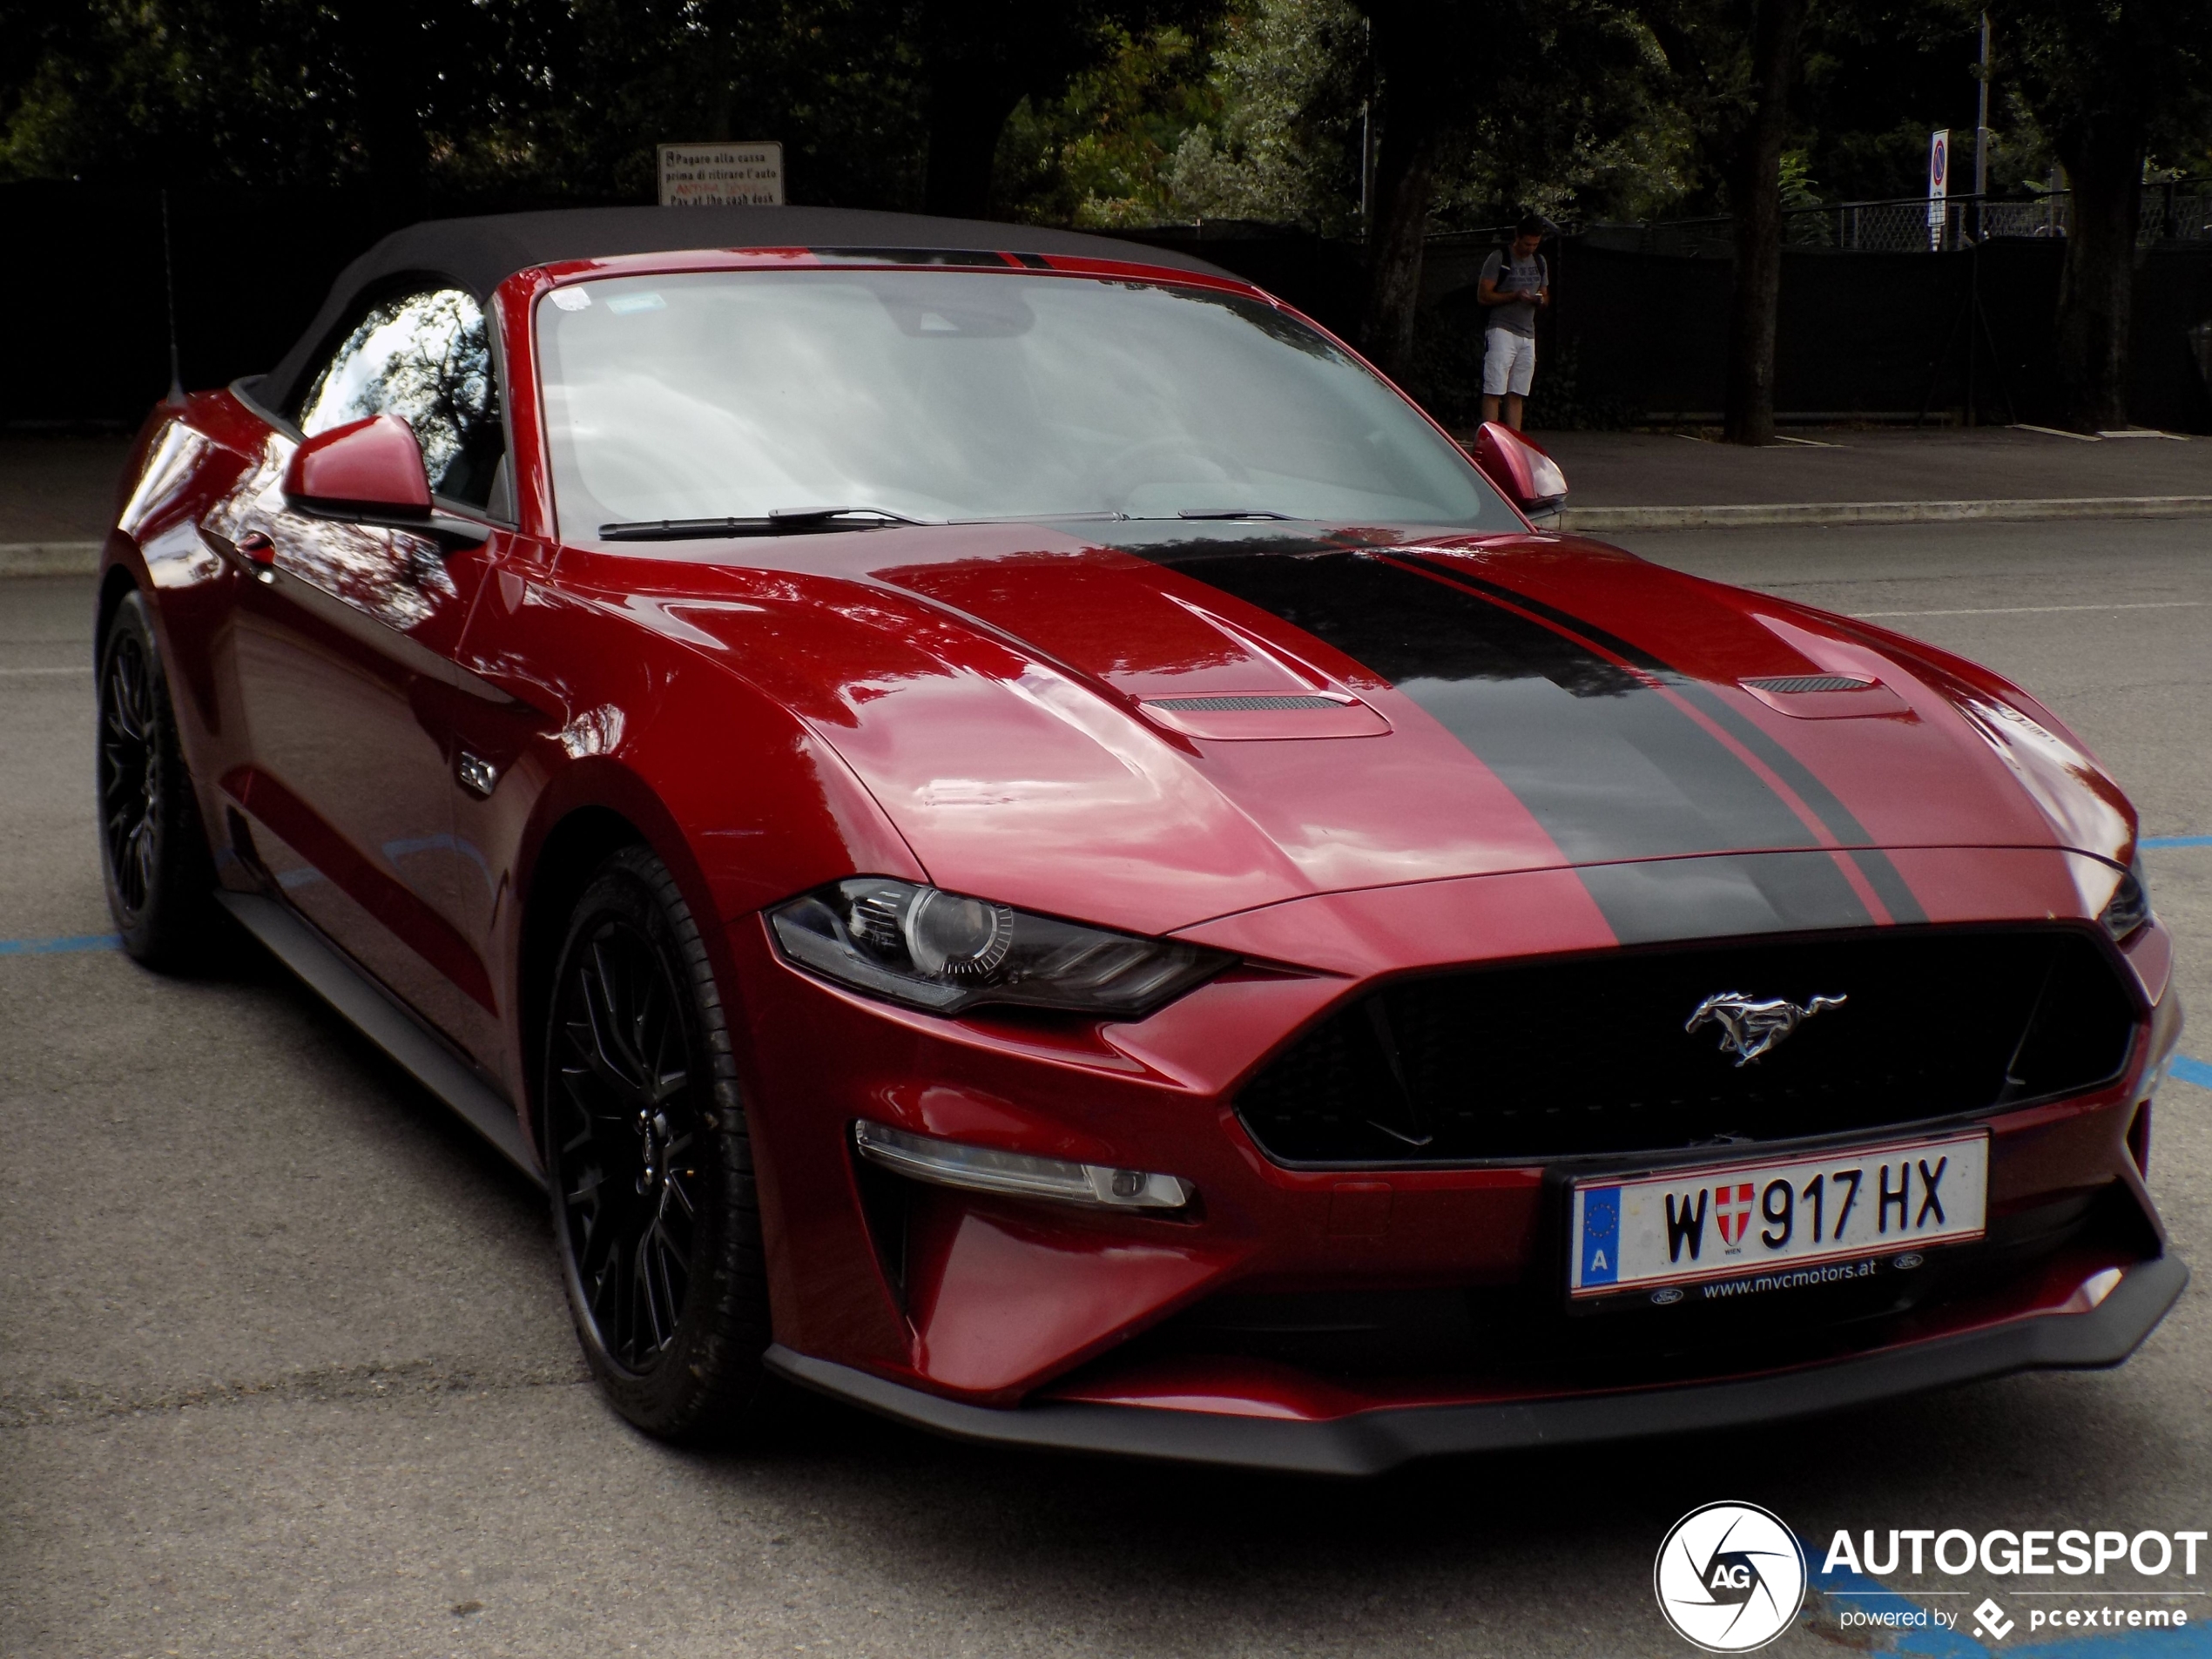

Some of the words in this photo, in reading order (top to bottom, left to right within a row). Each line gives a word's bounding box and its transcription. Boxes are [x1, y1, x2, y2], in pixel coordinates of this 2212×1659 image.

[676, 153, 711, 165] Pagare
[714, 153, 734, 164] alla
[738, 154, 765, 163] cassa
[665, 170, 693, 182] prima
[697, 169, 705, 180] di
[709, 169, 744, 179] ritirare
[671, 195, 688, 206] Pay
[692, 195, 702, 206] at
[706, 194, 723, 206] the
[725, 193, 748, 205] cash
[752, 192, 774, 204] desk
[1665, 1188, 1709, 1263] W
[1761, 1168, 1863, 1251] 917
[1878, 1156, 1948, 1234] HX
[1724, 1247, 1742, 1256] WIEN
[1591, 1250, 1608, 1271] A
[1704, 1259, 1876, 1298] www.mvcmotors.at
